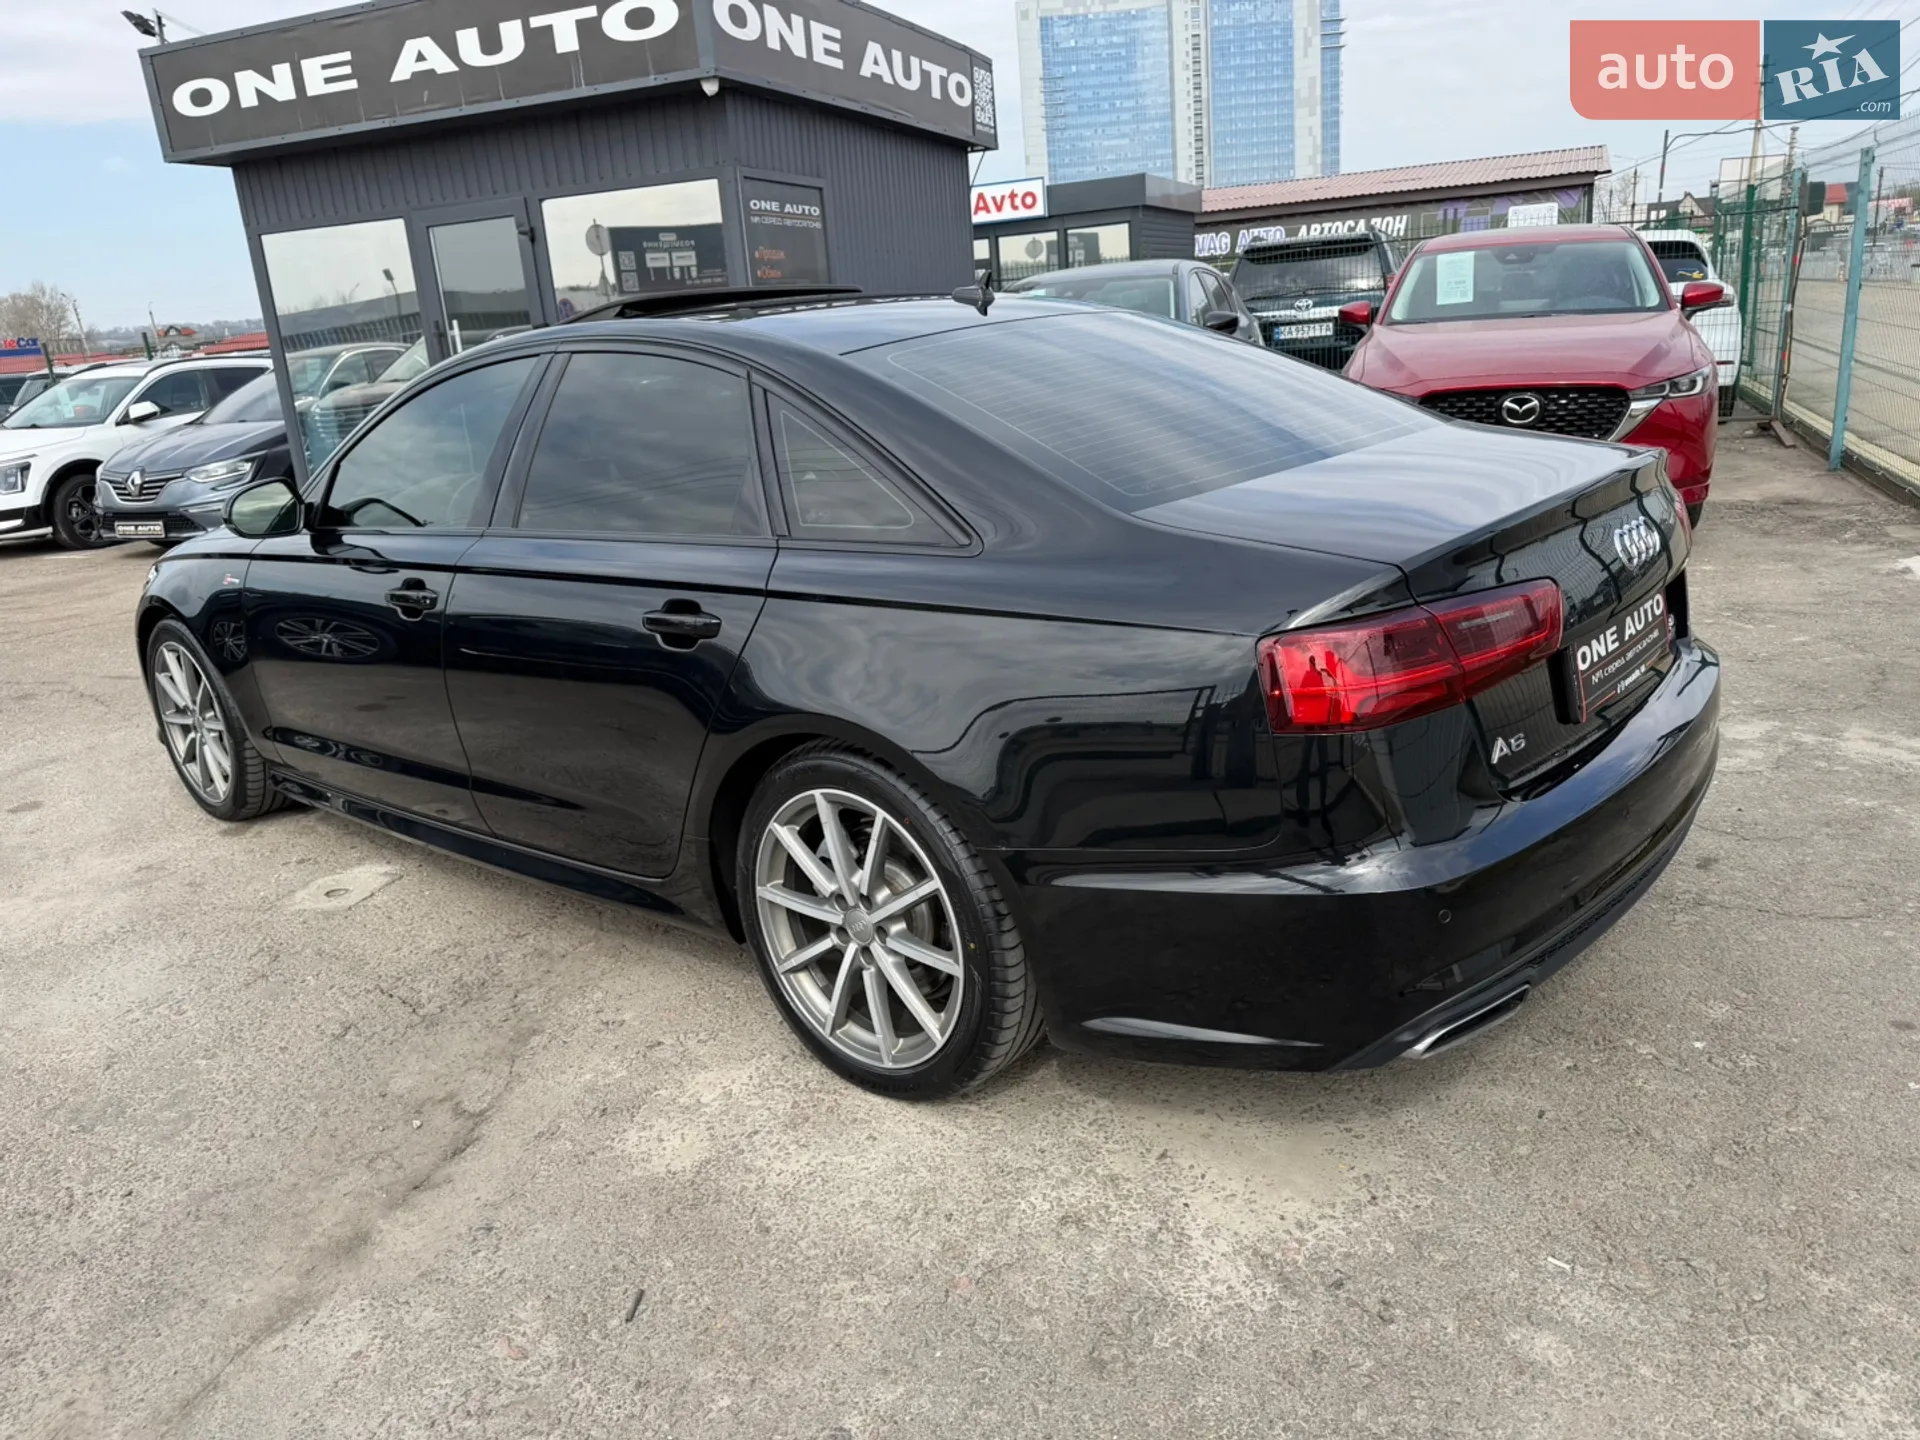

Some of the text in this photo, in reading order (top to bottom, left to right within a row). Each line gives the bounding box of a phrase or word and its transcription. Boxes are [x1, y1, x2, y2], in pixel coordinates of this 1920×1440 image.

[171, 0, 679, 117] ONE AUTO
[713, 0, 972, 107] ONE AUTO
[750, 199, 820, 216] ONE AUTO
[973, 188, 1037, 215] Avto
[1577, 625, 1620, 671] ONE
[1624, 593, 1664, 641] AUTO
[1490, 733, 1526, 764] A6
